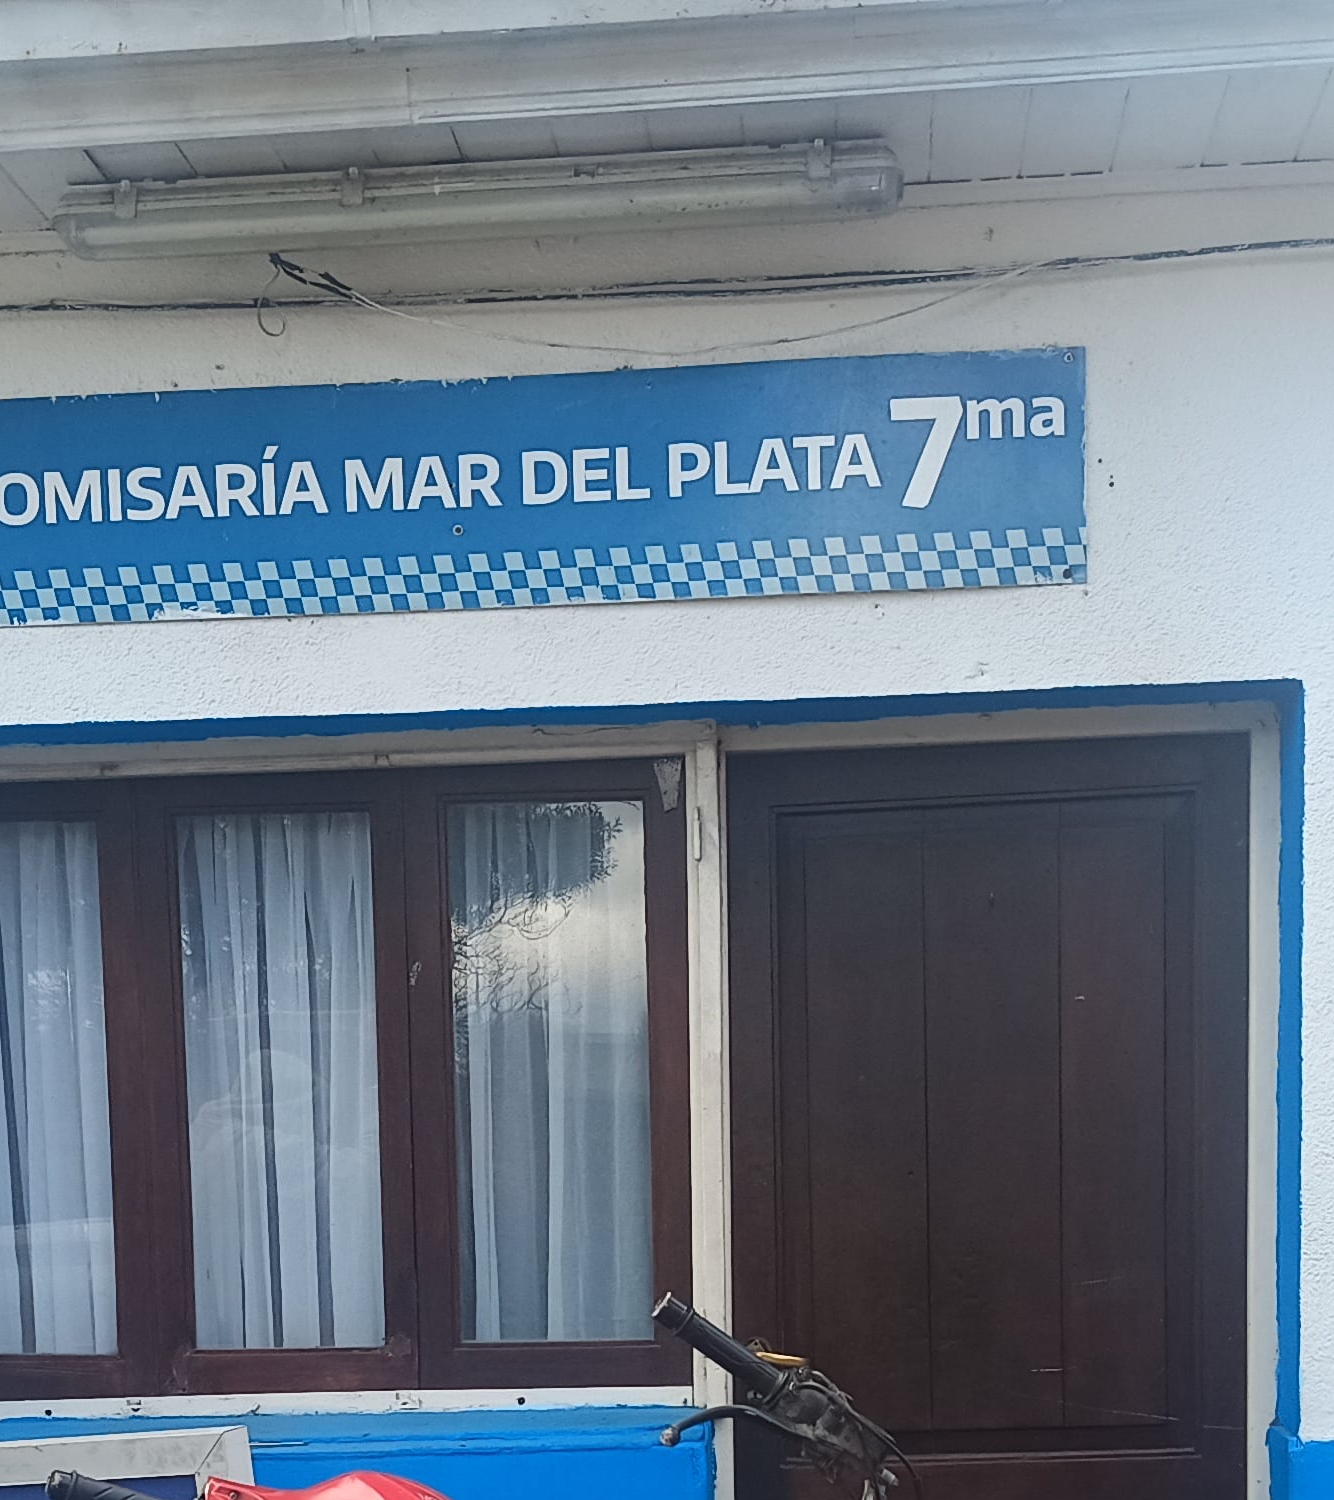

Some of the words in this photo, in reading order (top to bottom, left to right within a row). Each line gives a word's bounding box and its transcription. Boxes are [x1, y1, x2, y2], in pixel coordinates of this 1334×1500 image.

[344, 453, 503, 513] MAR
[521, 446, 651, 505] DEL
[667, 433, 882, 498] PLATA
